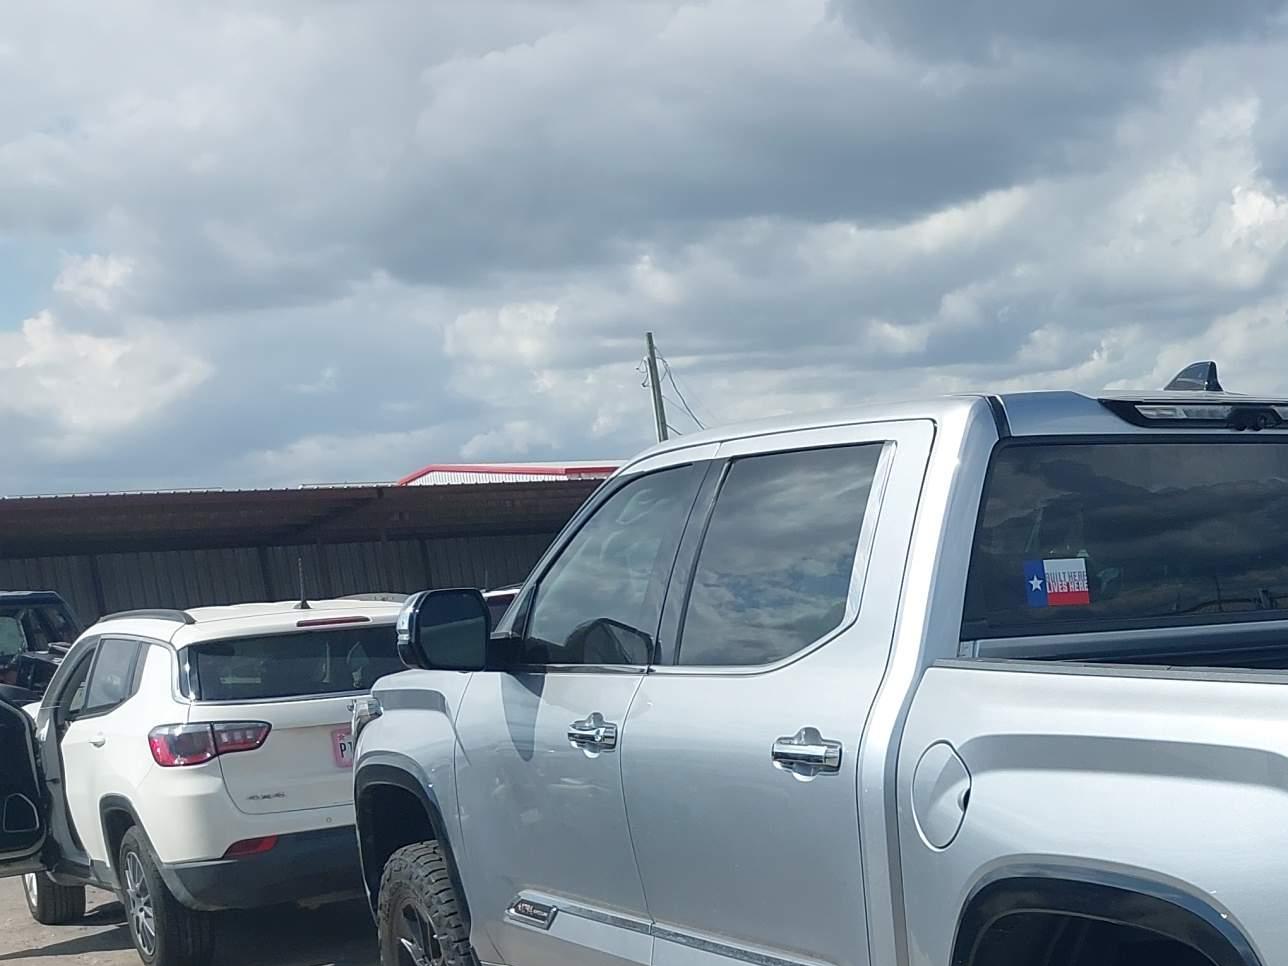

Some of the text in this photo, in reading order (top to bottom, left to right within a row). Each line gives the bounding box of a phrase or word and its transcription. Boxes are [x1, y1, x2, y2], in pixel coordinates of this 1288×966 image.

[1045, 570, 1088, 582] BUILT HERE
[1046, 581, 1089, 593] LIVES HERE
